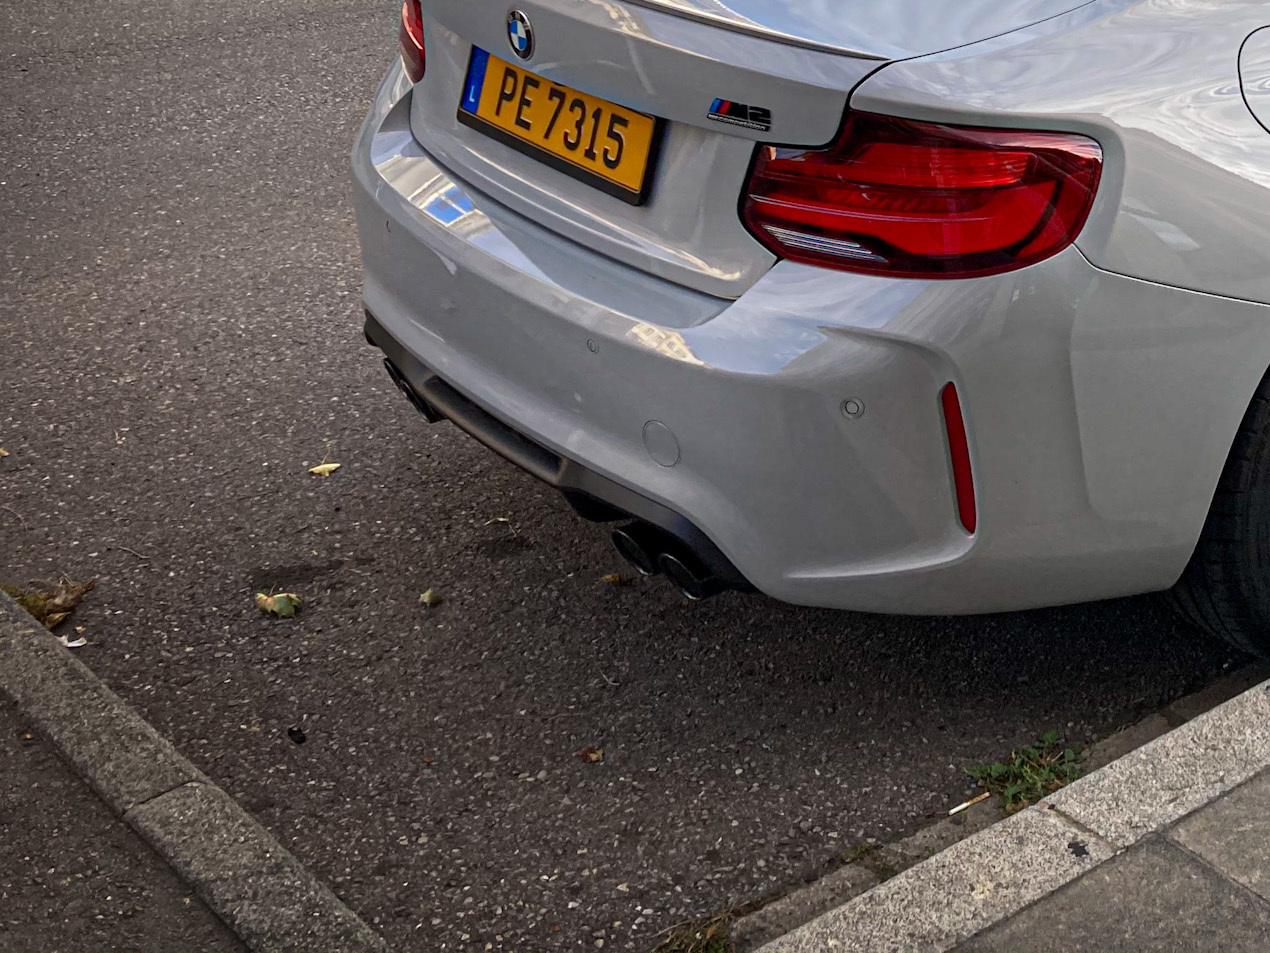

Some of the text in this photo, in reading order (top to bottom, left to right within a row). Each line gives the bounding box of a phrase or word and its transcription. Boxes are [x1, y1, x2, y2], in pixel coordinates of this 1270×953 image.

[470, 84, 475, 103] L
[495, 66, 629, 170] PE 7315
